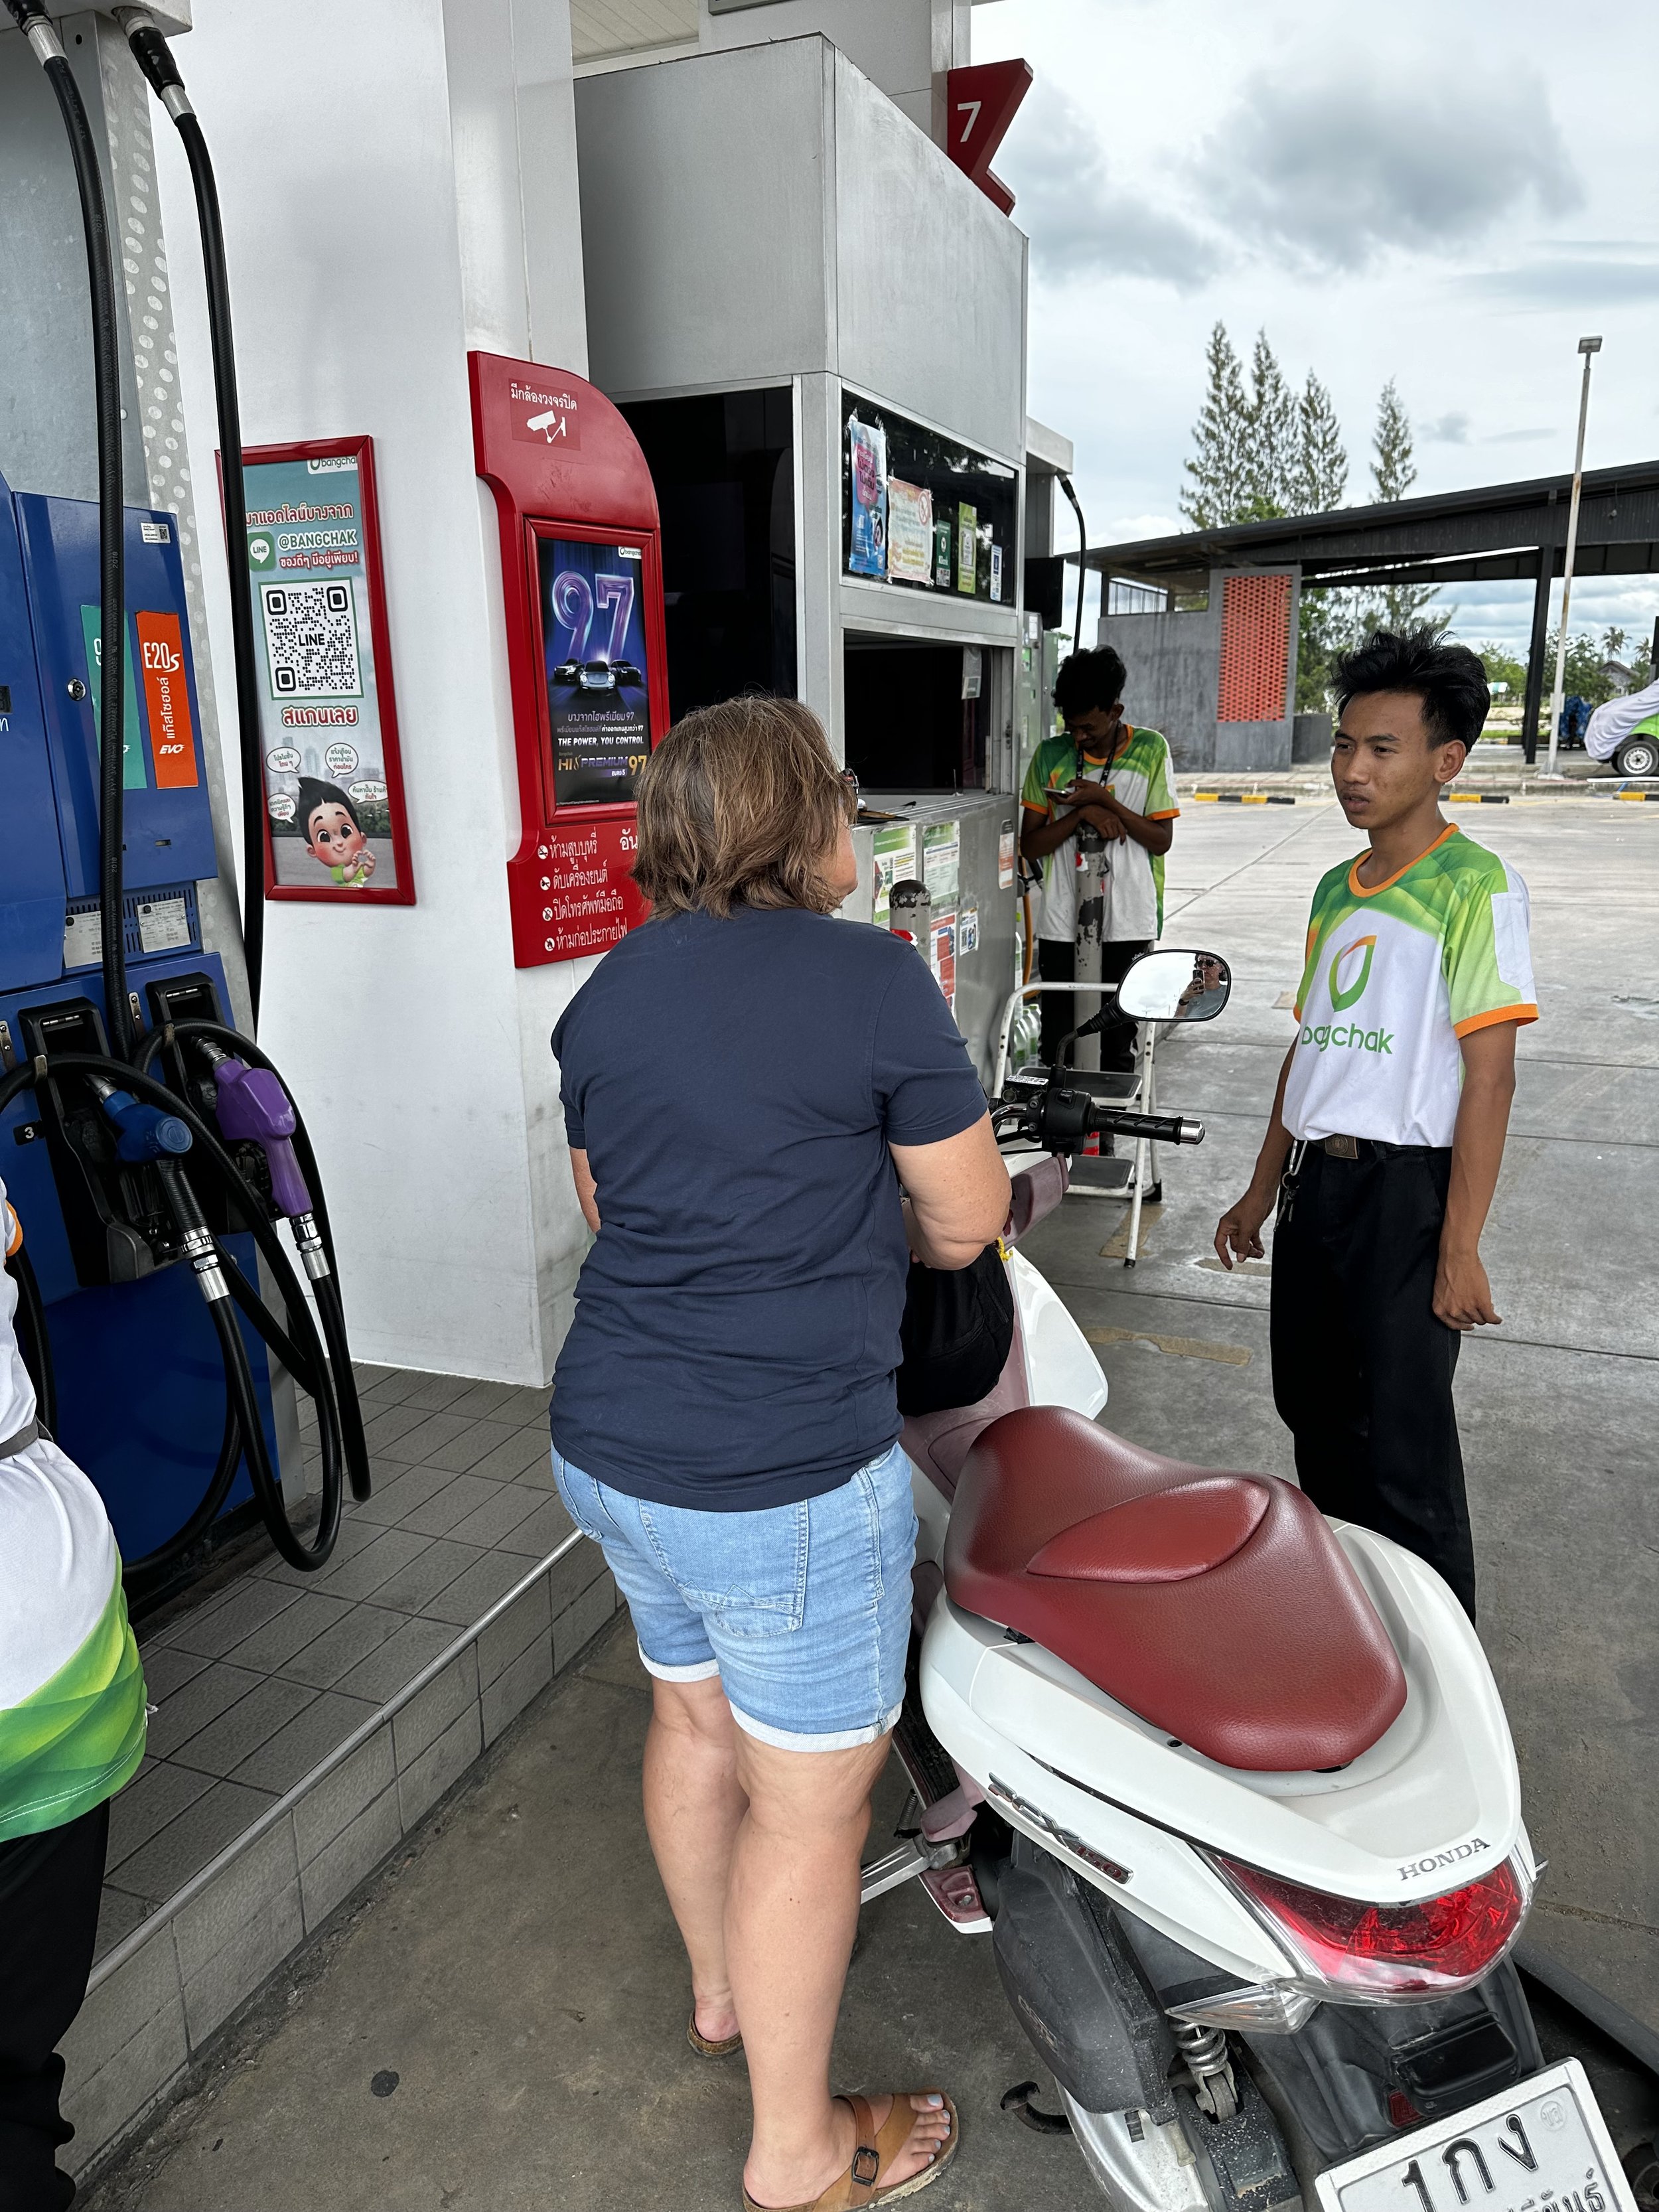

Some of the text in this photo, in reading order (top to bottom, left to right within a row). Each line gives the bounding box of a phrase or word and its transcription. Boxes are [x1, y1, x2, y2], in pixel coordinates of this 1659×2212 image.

[958, 101, 981, 143] 7
[511, 383, 577, 410] มีกล้องวงจรปิด
[321, 457, 356, 468] bangcha
[246, 502, 354, 526] มาแอดไลน์บางจาก
[279, 531, 356, 550] @BANGCHAK
[313, 551, 358, 568] มีอยู่เพียบ!
[551, 571, 635, 664] 97
[298, 633, 325, 646] LINE
[157, 677, 175, 739] แก๊สโซฮอล์
[283, 706, 358, 726] สแกนเลย
[159, 744, 185, 755] EVO
[558, 738, 572, 747] THE
[601, 737, 614, 745] YOU
[615, 735, 644, 745] CONTROL
[581, 756, 628, 769] PREMIUM
[628, 755, 647, 776] 97
[549, 826, 639, 865] ห้ามสูบบุหรี่ อัน
[553, 859, 609, 890] ดับเครื่องยนต์
[553, 889, 624, 921] ปิดโทรศัพท์มือถือ
[556, 917, 628, 950] ห้ามก่อประกายไฟ
[25, 1126, 35, 1139] 3
[1397, 1838, 1490, 1881] HONDA
